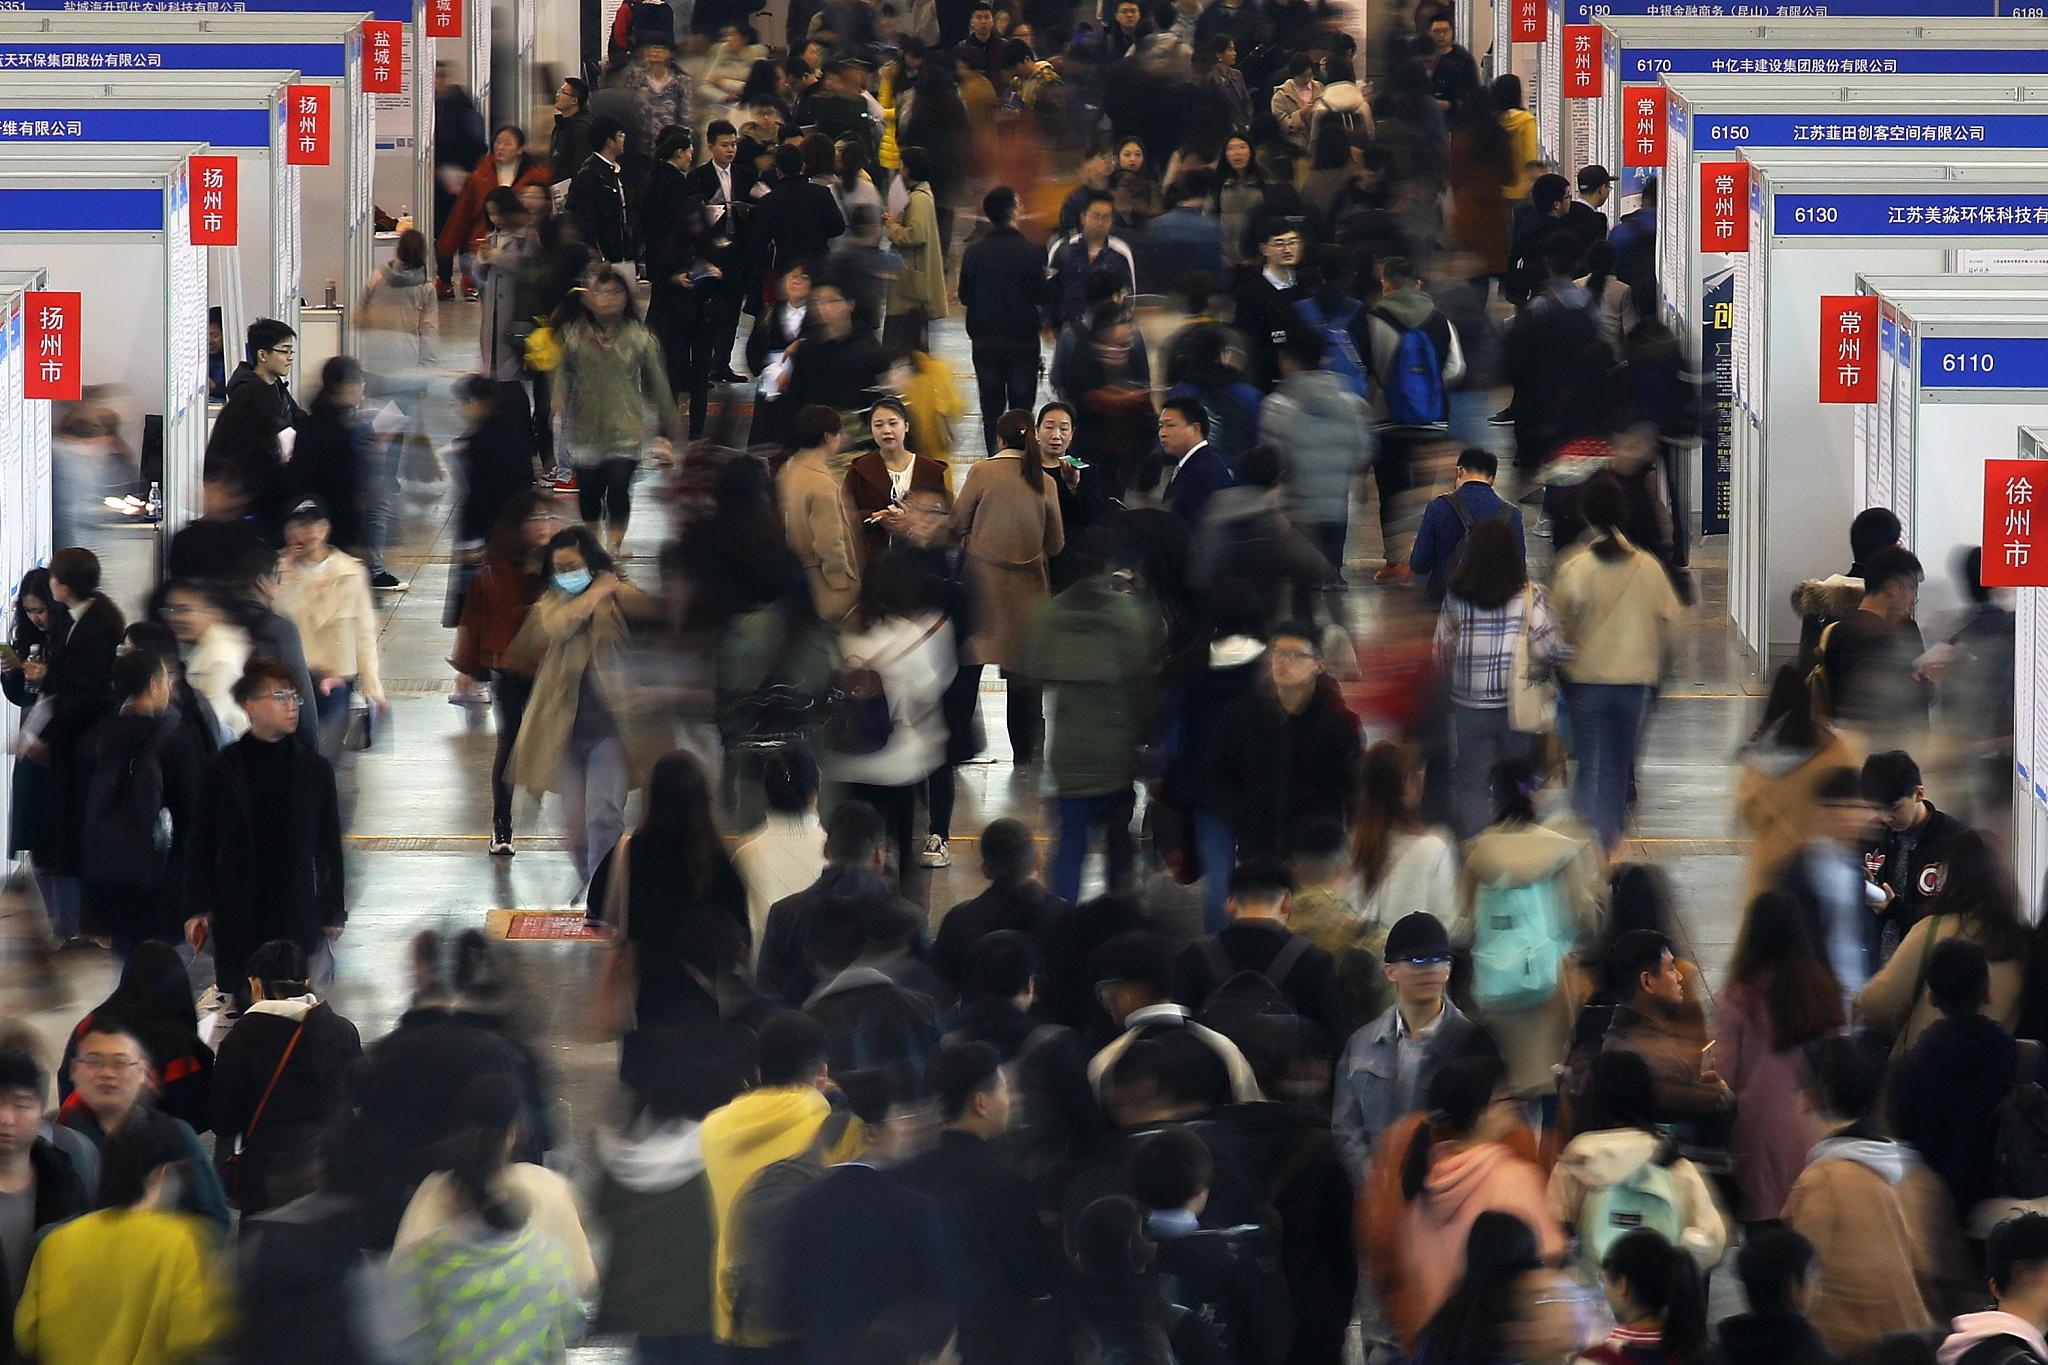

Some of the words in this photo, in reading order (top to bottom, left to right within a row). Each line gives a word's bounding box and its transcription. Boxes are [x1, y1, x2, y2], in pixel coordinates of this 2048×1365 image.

[1579, 5, 1610, 16] 6190
[2012, 8, 2044, 17] 6189
[374, 30, 391, 82] 盐城市
[1574, 35, 1592, 87] 苏州市
[1637, 59, 1672, 74] 6170
[1711, 58, 1898, 74] 中亿丰建设集团股份有限公司
[0, 120, 82, 137] 维有限公司
[298, 96, 318, 153] 扬州市
[1636, 98, 1655, 155] 常州市
[1711, 125, 1750, 140] 6150
[202, 168, 224, 232] 扬州市
[1714, 174, 1735, 239] 常州市
[1794, 207, 1838, 223] 6130
[1888, 206, 2048, 224] 江苏美淼环保科技有
[39, 306, 64, 383] 扬州市
[1837, 310, 1862, 387] 常州市
[1942, 354, 1994, 372] 6110
[2003, 476, 2033, 568] 徐州市
